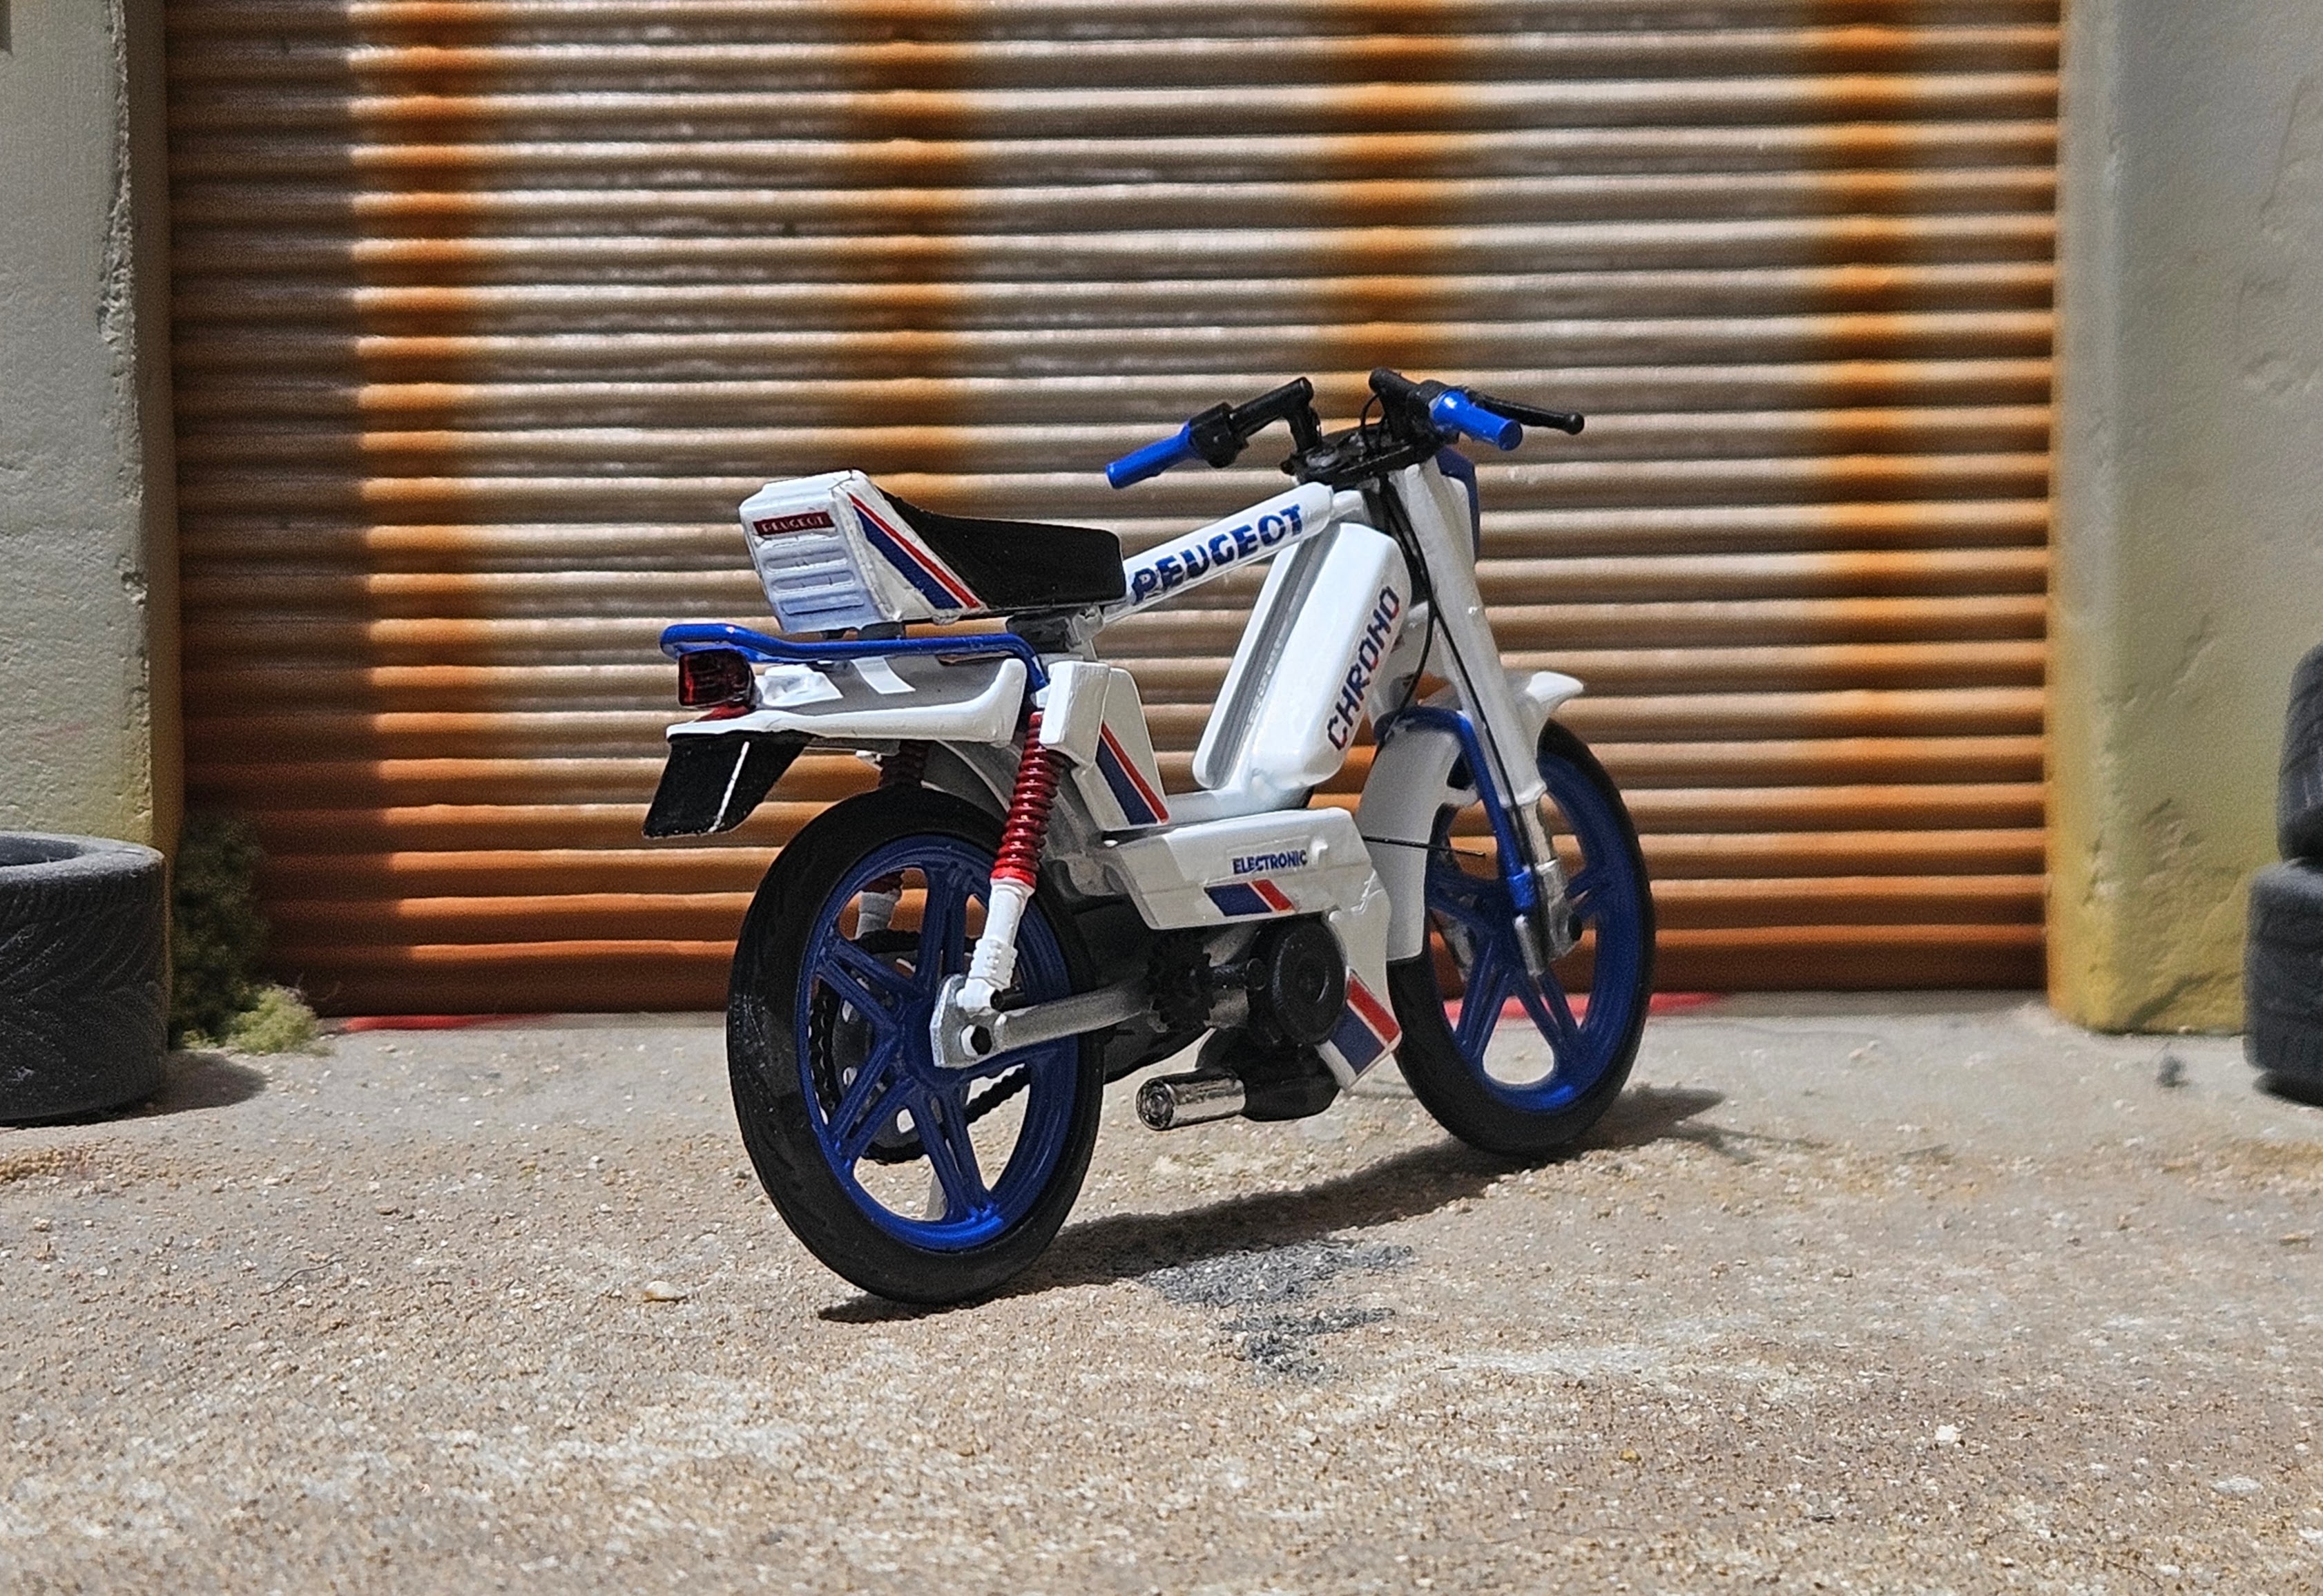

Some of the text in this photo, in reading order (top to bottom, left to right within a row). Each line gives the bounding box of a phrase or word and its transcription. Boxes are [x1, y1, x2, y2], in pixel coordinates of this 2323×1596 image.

[761, 516, 825, 532] PEUGEOT
[1131, 503, 1303, 606] PEUGEOT
[1327, 586, 1400, 751] CHRONO
[1232, 849, 1308, 874] ELECTRONIC
